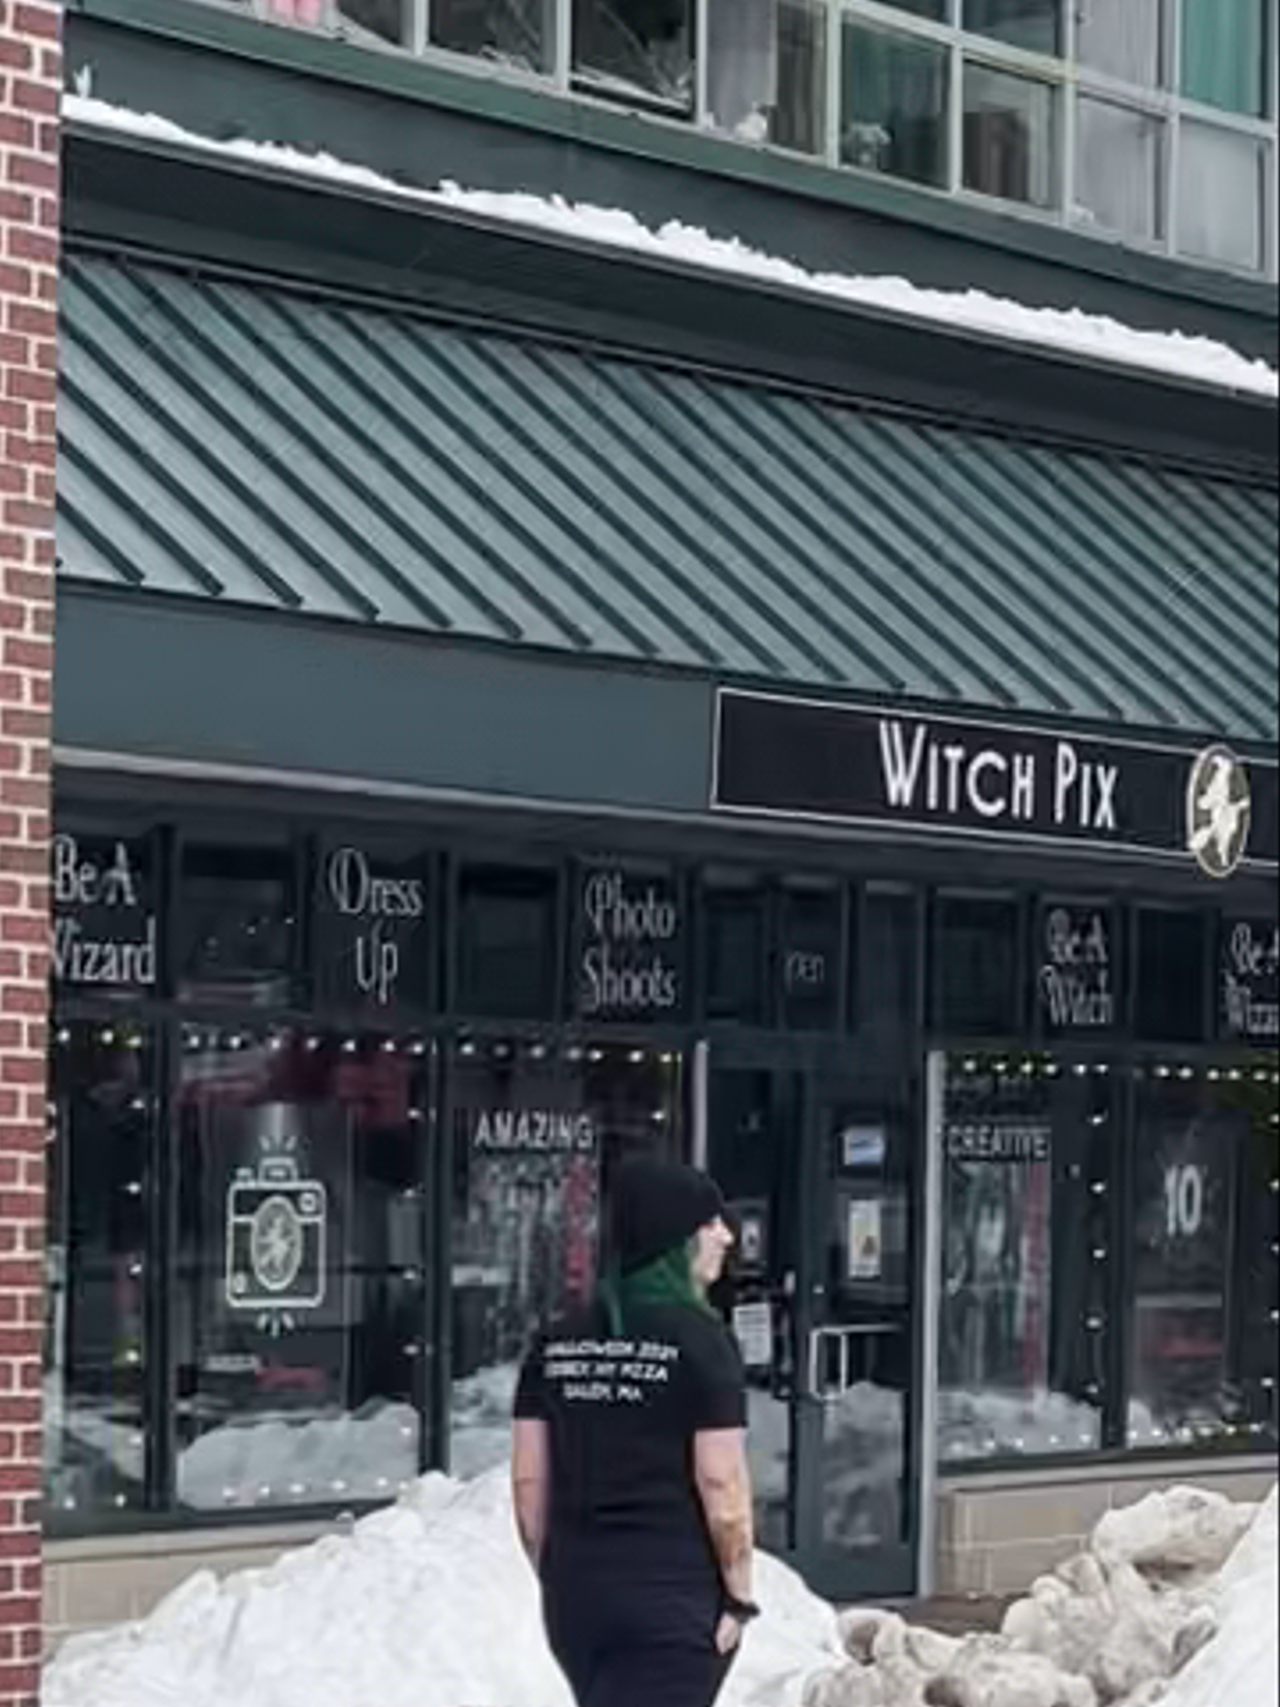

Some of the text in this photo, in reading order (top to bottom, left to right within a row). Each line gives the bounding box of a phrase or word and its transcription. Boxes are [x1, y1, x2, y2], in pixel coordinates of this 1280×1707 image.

[101, 840, 138, 906] A
[329, 846, 424, 917] Dress
[584, 869, 676, 941] Photo
[355, 919, 399, 1001] Up
[582, 943, 677, 1014] Shoots
[473, 1109, 594, 1149] AMAZING
[1164, 1163, 1202, 1236] 10
[620, 1363, 669, 1383] PIZZA
